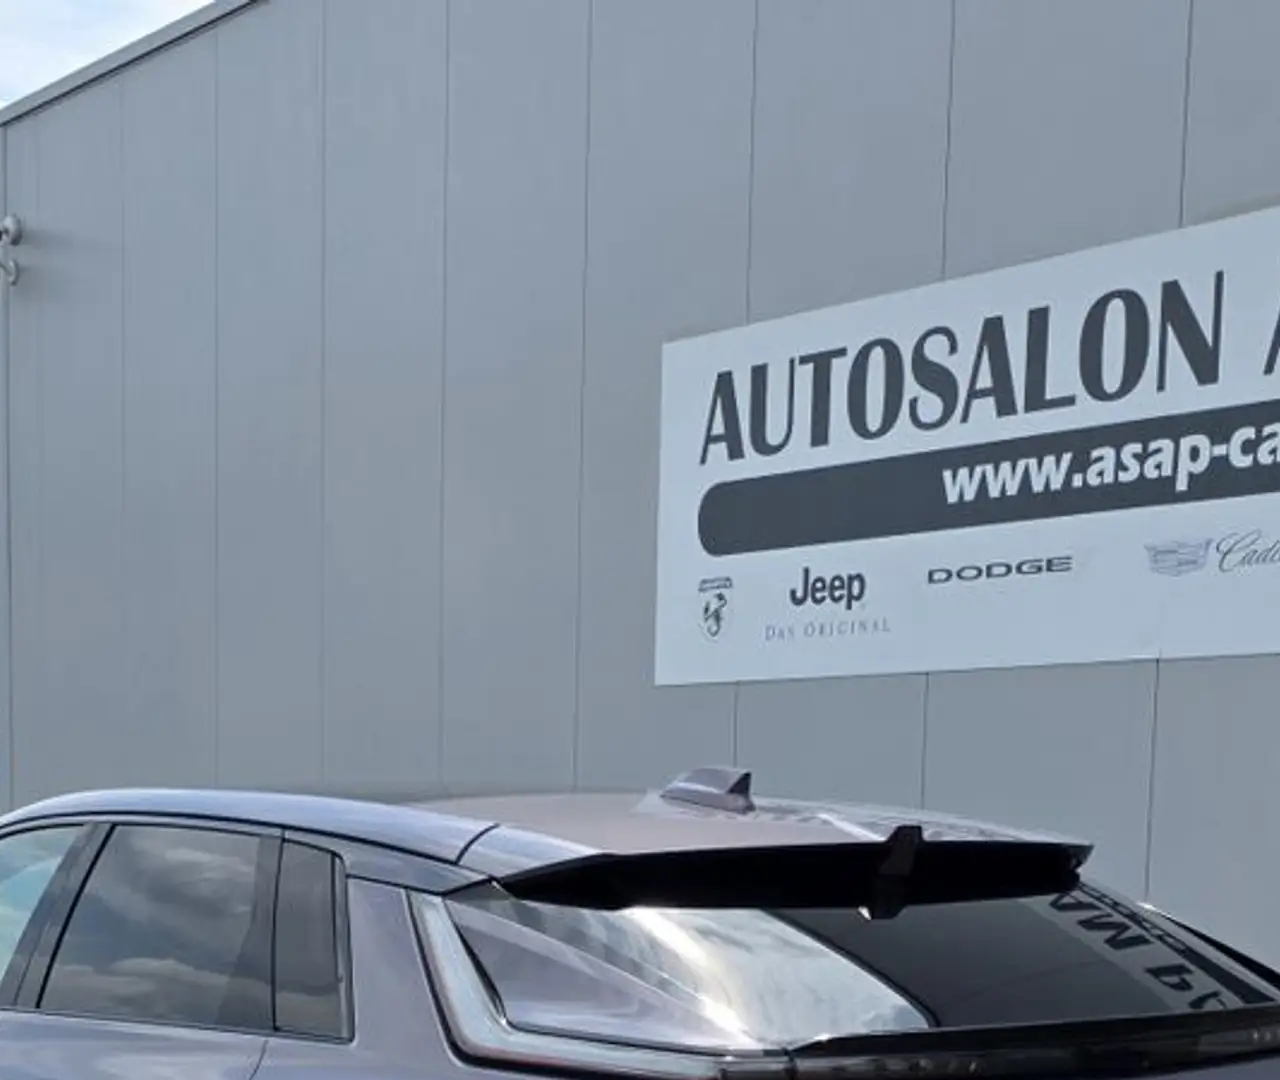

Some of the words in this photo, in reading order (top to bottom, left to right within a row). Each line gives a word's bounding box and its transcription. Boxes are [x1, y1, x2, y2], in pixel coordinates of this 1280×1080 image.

[699, 270, 1225, 466] AUTOSALON
[789, 565, 867, 611] Jeep
[927, 555, 1074, 585] DODGE
